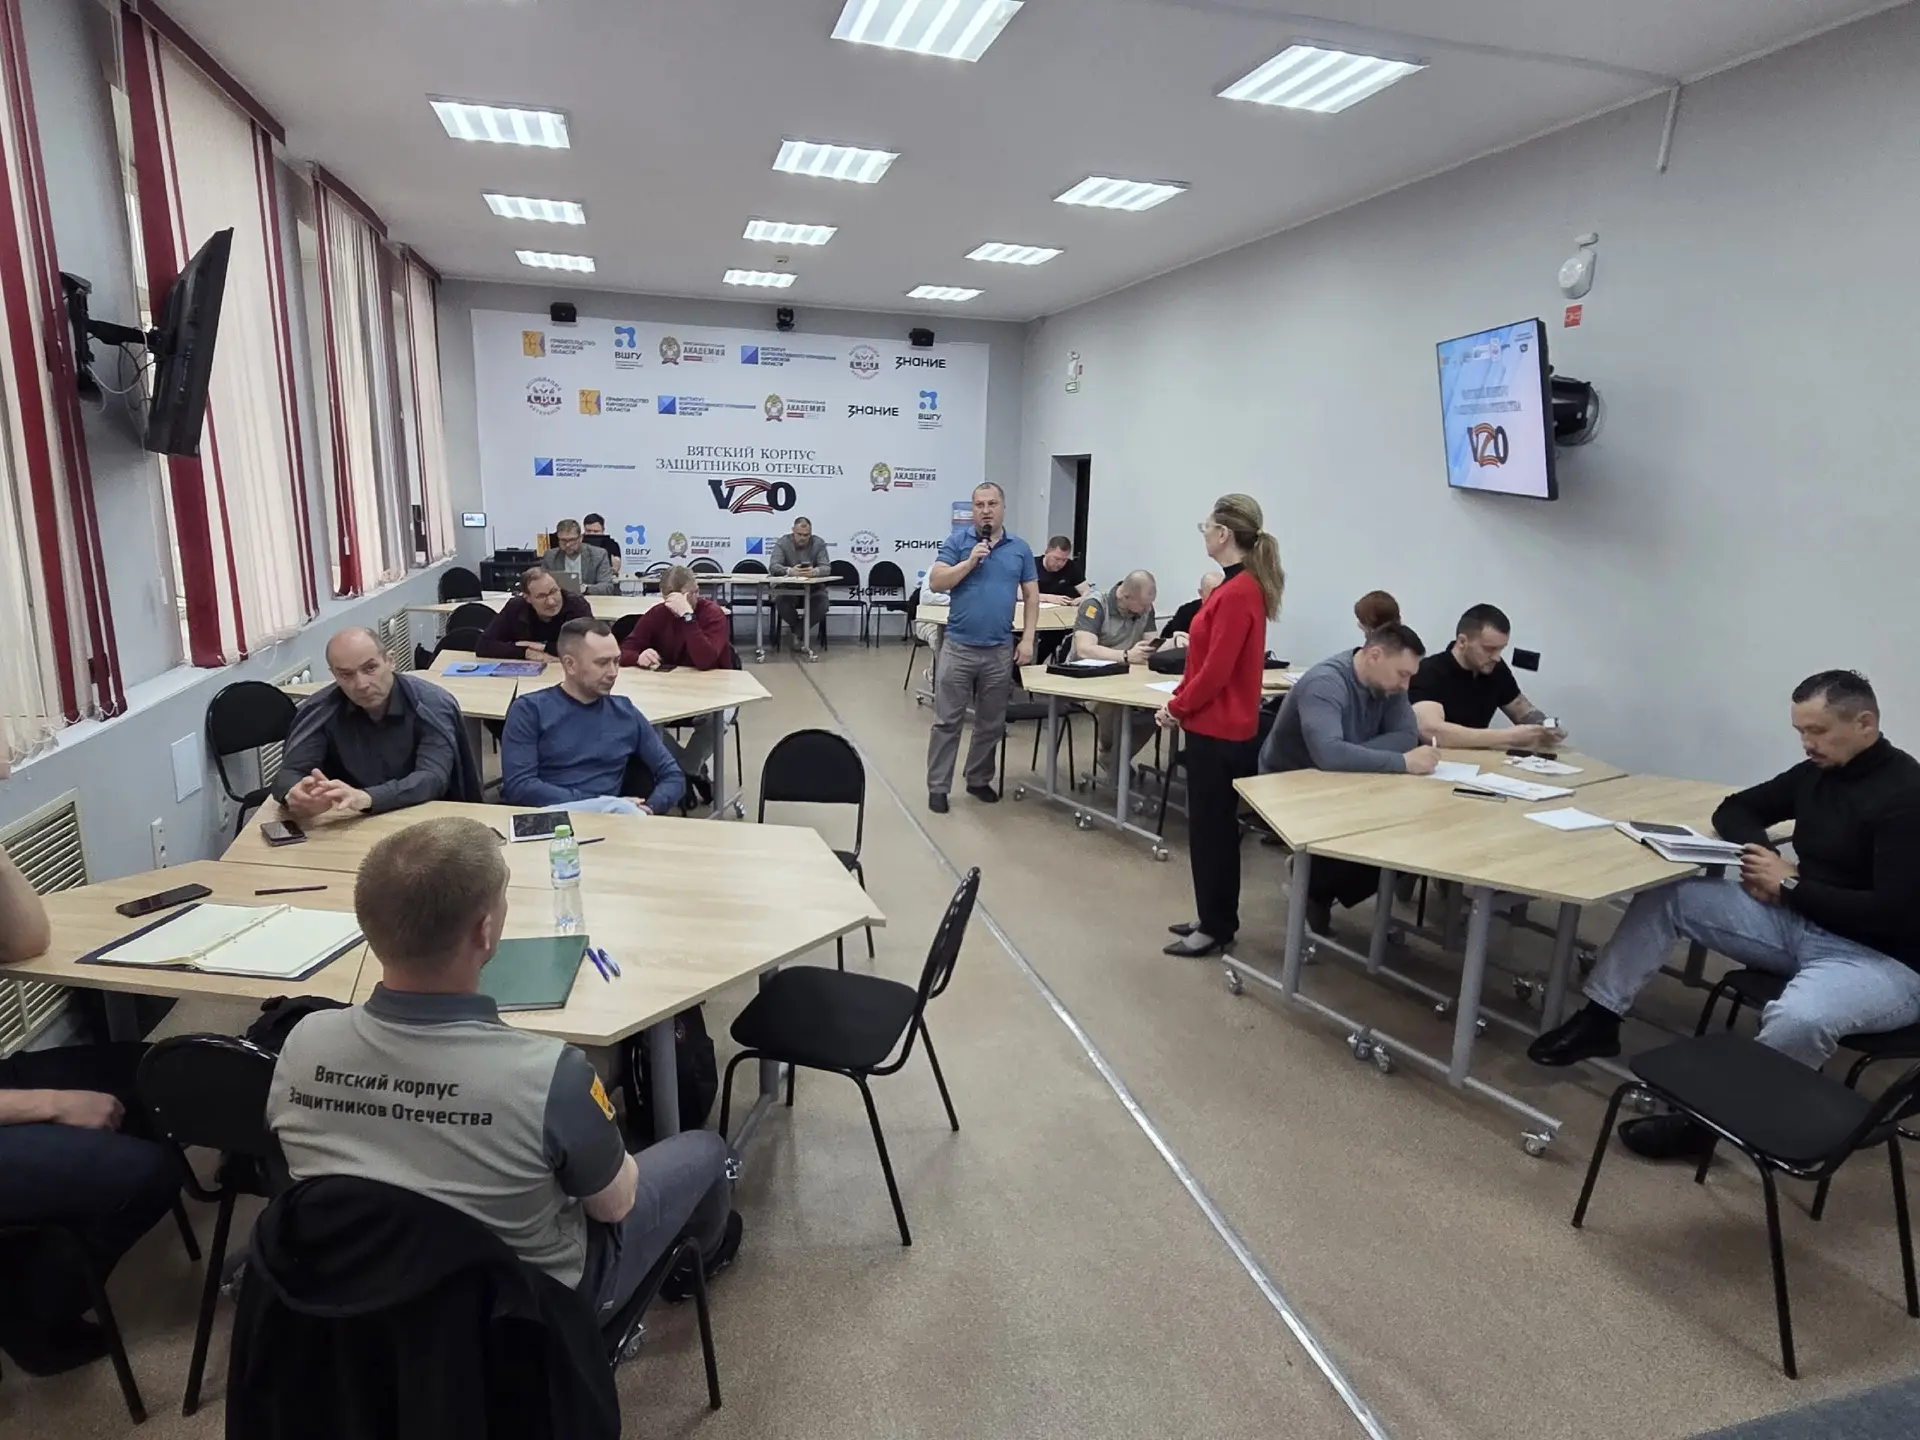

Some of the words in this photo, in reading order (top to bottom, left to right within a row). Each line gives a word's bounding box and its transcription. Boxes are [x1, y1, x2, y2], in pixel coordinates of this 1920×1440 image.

[614, 351, 642, 360] ВШГУ
[683, 347, 726, 357] АКАДЕМИЯ
[895, 356, 947, 370] ЗНАНИЕ
[786, 404, 826, 413] АКАДЕМИЯ
[847, 405, 899, 418] ЗНАНИЕ
[918, 413, 941, 421] ВШГУ
[687, 445, 754, 459] ВЯТСКИЙ
[760, 448, 816, 461] КОРПУС
[656, 458, 760, 472] ЗАЩИТНИКОВ
[765, 462, 844, 476] ОТЕЧЕСТВА
[893, 472, 937, 482] АКАДЕМИЯ
[690, 540, 732, 549] АКАДЕМИЯ
[625, 548, 651, 556] ВШГУ
[314, 1064, 388, 1091] Вятский
[393, 1077, 459, 1099] корпус
[289, 1086, 387, 1118] Защитников
[391, 1102, 493, 1126] Отечества
